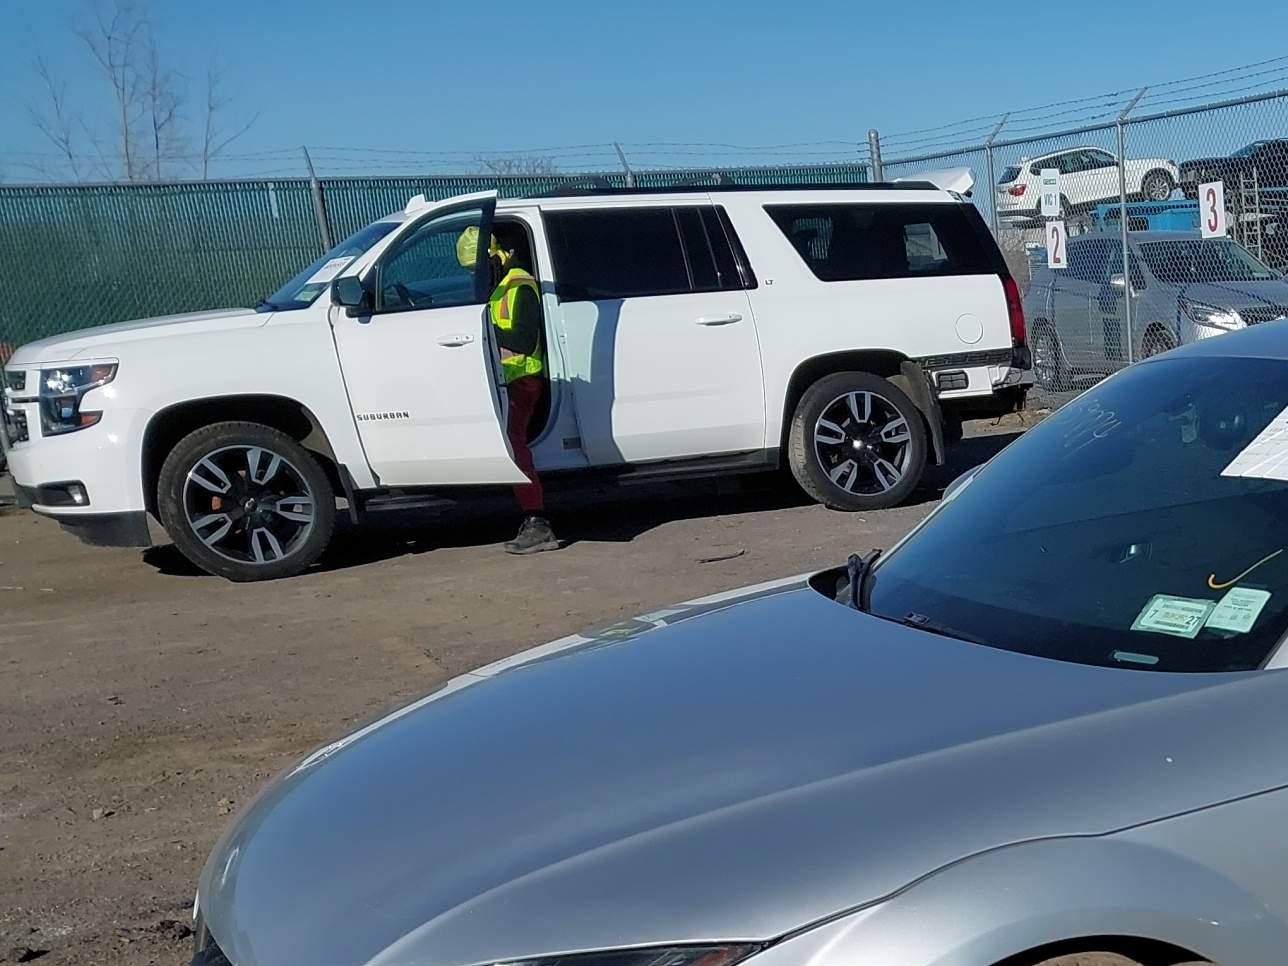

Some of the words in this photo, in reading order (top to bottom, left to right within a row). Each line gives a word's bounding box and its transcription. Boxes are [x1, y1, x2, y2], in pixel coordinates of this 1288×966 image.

[1206, 187, 1218, 232] 3
[1051, 226, 1062, 264] 2
[356, 411, 410, 421] SUBURBAN
